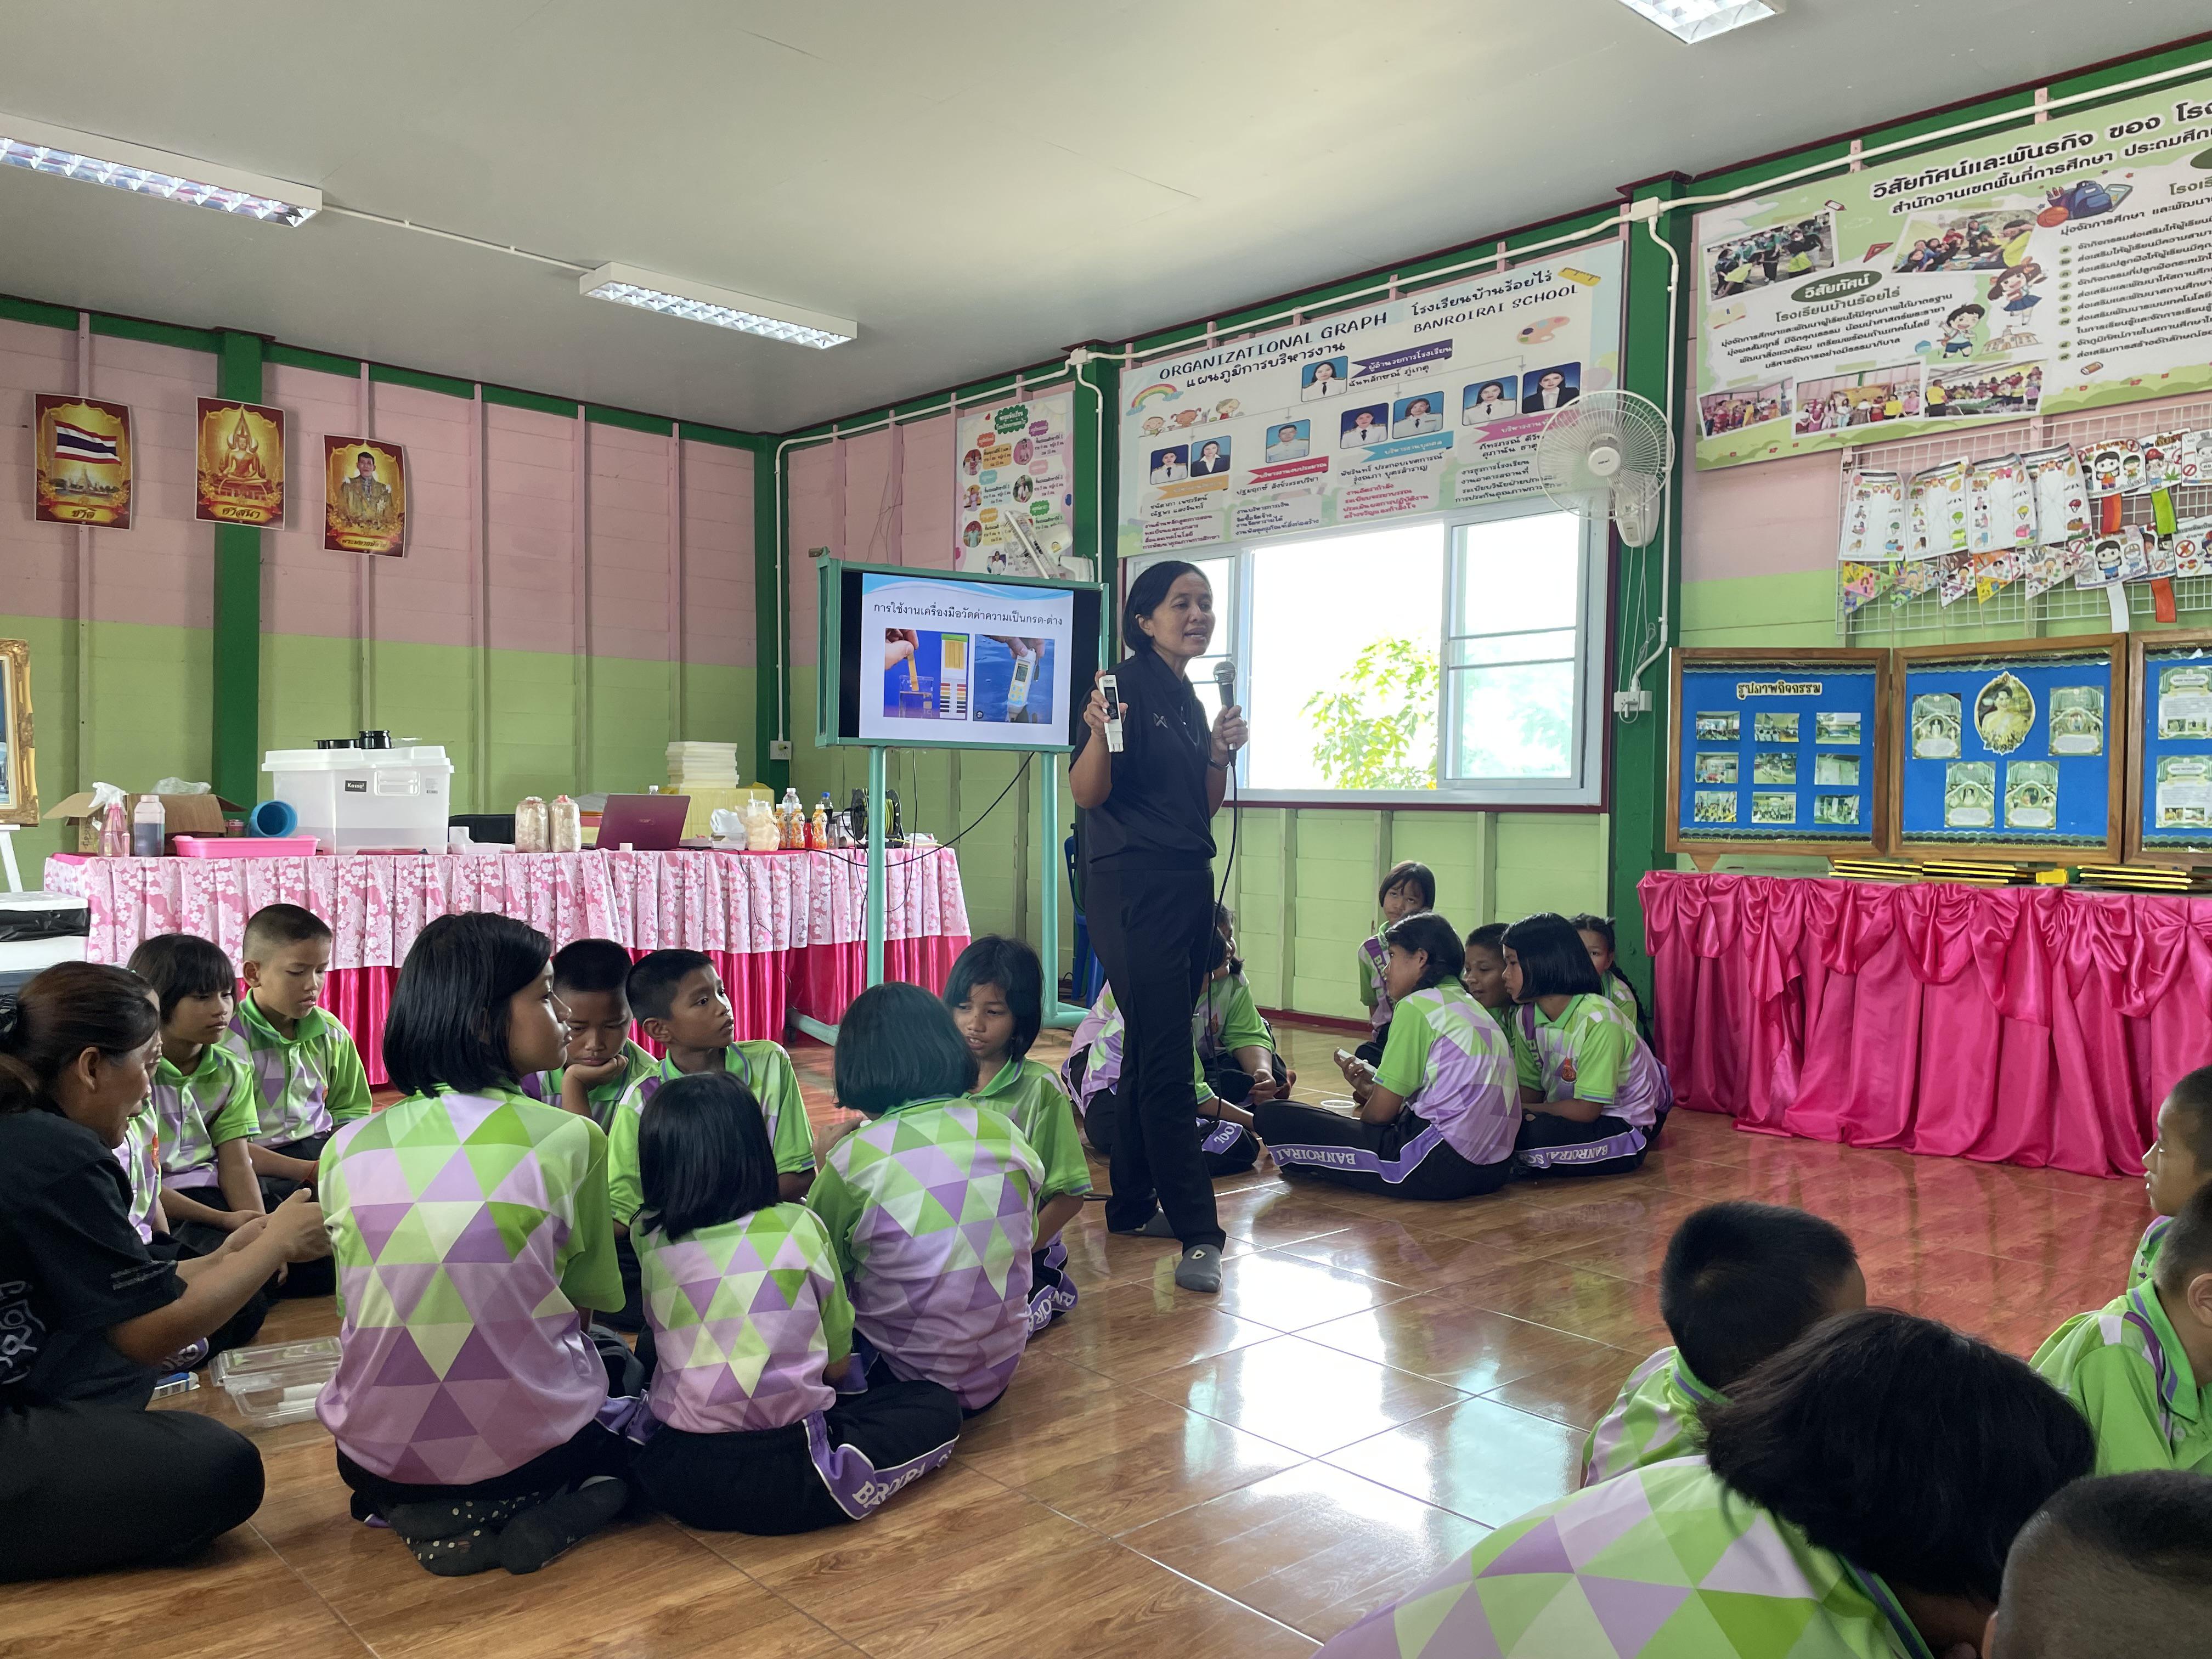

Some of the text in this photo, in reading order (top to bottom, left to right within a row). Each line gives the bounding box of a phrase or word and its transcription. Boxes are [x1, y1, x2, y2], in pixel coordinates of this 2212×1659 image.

[1873, 132, 2094, 198] วิสัยทัศน์และพันธกิจ
[2109, 116, 2160, 139] ของ
[1893, 126, 2212, 214] สำนักงานเขตพื้นที่การศึกษา ประถมศึก
[2061, 196, 2212, 236] มุ่งจัดการศึกษา และพัฒนา
[1411, 269, 1553, 317] โรงเรียนบ้านร้อยไร่
[1775, 286, 1900, 323] โรงเรียนบ้านร้อยไร่
[1804, 273, 1870, 299] วิสัยทัศน์
[1414, 285, 1579, 333] BANROIRAI SCHOOL
[1159, 311, 1388, 380] ORGANIZATIONAL GRAPH
[1369, 347, 1452, 372] ผู้อำนวยการโรงเรียน
[1186, 342, 1346, 387] แผนภูมิการบริหารงาน
[71, 508, 96, 520] ชาติ
[222, 507, 261, 519] ศาสนา
[874, 602, 1063, 626] การใช้งานเครื่องมือวัดค่าความเป็นกรด-ด่าง
[1737, 681, 1821, 698] รูปภาพกิจกรรม
[1276, 1148, 1356, 1165] BANROIRAI
